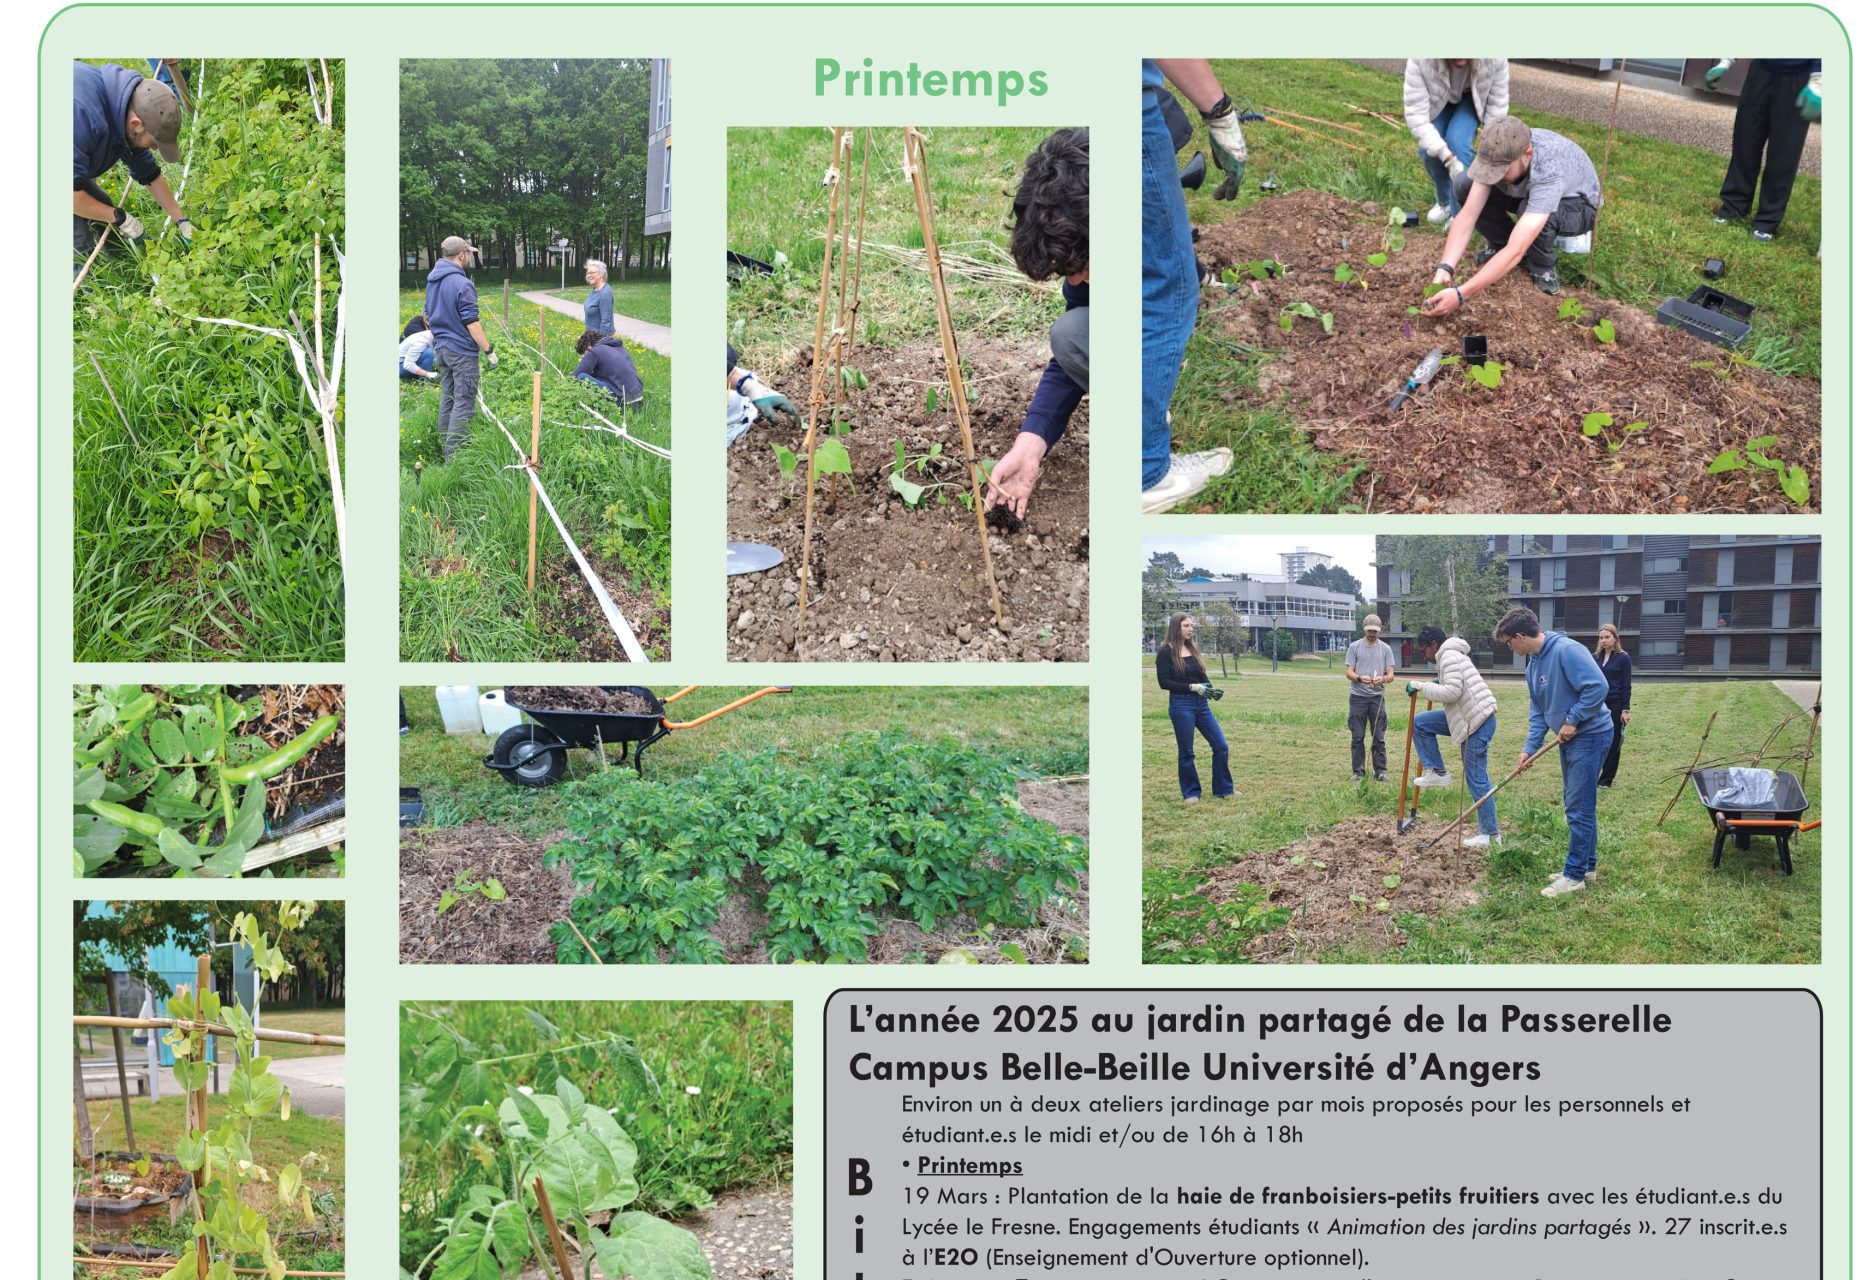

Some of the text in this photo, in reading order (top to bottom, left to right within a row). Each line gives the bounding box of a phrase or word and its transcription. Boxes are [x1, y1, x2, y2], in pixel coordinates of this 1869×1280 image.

[815, 57, 1049, 107] Printemps
[850, 1003, 1672, 1041] L’année 2025 au jardin partagé de la Passerelle
[849, 1051, 1541, 1089] Campus Belle-Beille Université d’Angers
[902, 1094, 1691, 1117] Environ un à deux ateliers jardinage par mois proposés pour les personnels et
[901, 1122, 1303, 1149] étudiant.e.s le midi et/ou de 16h à 18h
[916, 1155, 1024, 1179] Printemps
[904, 1186, 930, 1205] 19
[936, 1187, 988, 1205] Mars
[1008, 1186, 1109, 1205] Plantation
[1116, 1186, 1143, 1205] de
[1150, 1186, 1169, 1205] la
[1177, 1186, 1223, 1205] haie
[1229, 1186, 1255, 1205] de
[1261, 1185, 1452, 1209] franboisiers-petits
[1458, 1186, 1540, 1205] fruitiers
[1547, 1192, 1595, 1205] avec
[1602, 1186, 1629, 1205] les
[1635, 1186, 1751, 1205] étudiant.e.s
[1757, 1186, 1783, 1205] du
[902, 1217, 959, 1240] Lycée
[966, 1217, 984, 1236] le
[991, 1217, 1061, 1236] Fresne.
[1069, 1217, 1202, 1240] Engagements
[1208, 1217, 1300, 1236] étudiants
[1326, 1217, 1426, 1236] Animation
[1432, 1216, 1465, 1236] des
[1471, 1216, 1538, 1240] jardins
[1543, 1217, 1632, 1240] partagés
[1664, 1217, 1692, 1236] 27
[1699, 1218, 1788, 1236] inscrit.e.s
[902, 1248, 915, 1266] à
[986, 1248, 1129, 1271] (Enseignement
[1135, 1245, 1257, 1266] d'Ouverture
[1264, 1248, 1369, 1271] optionnel).
